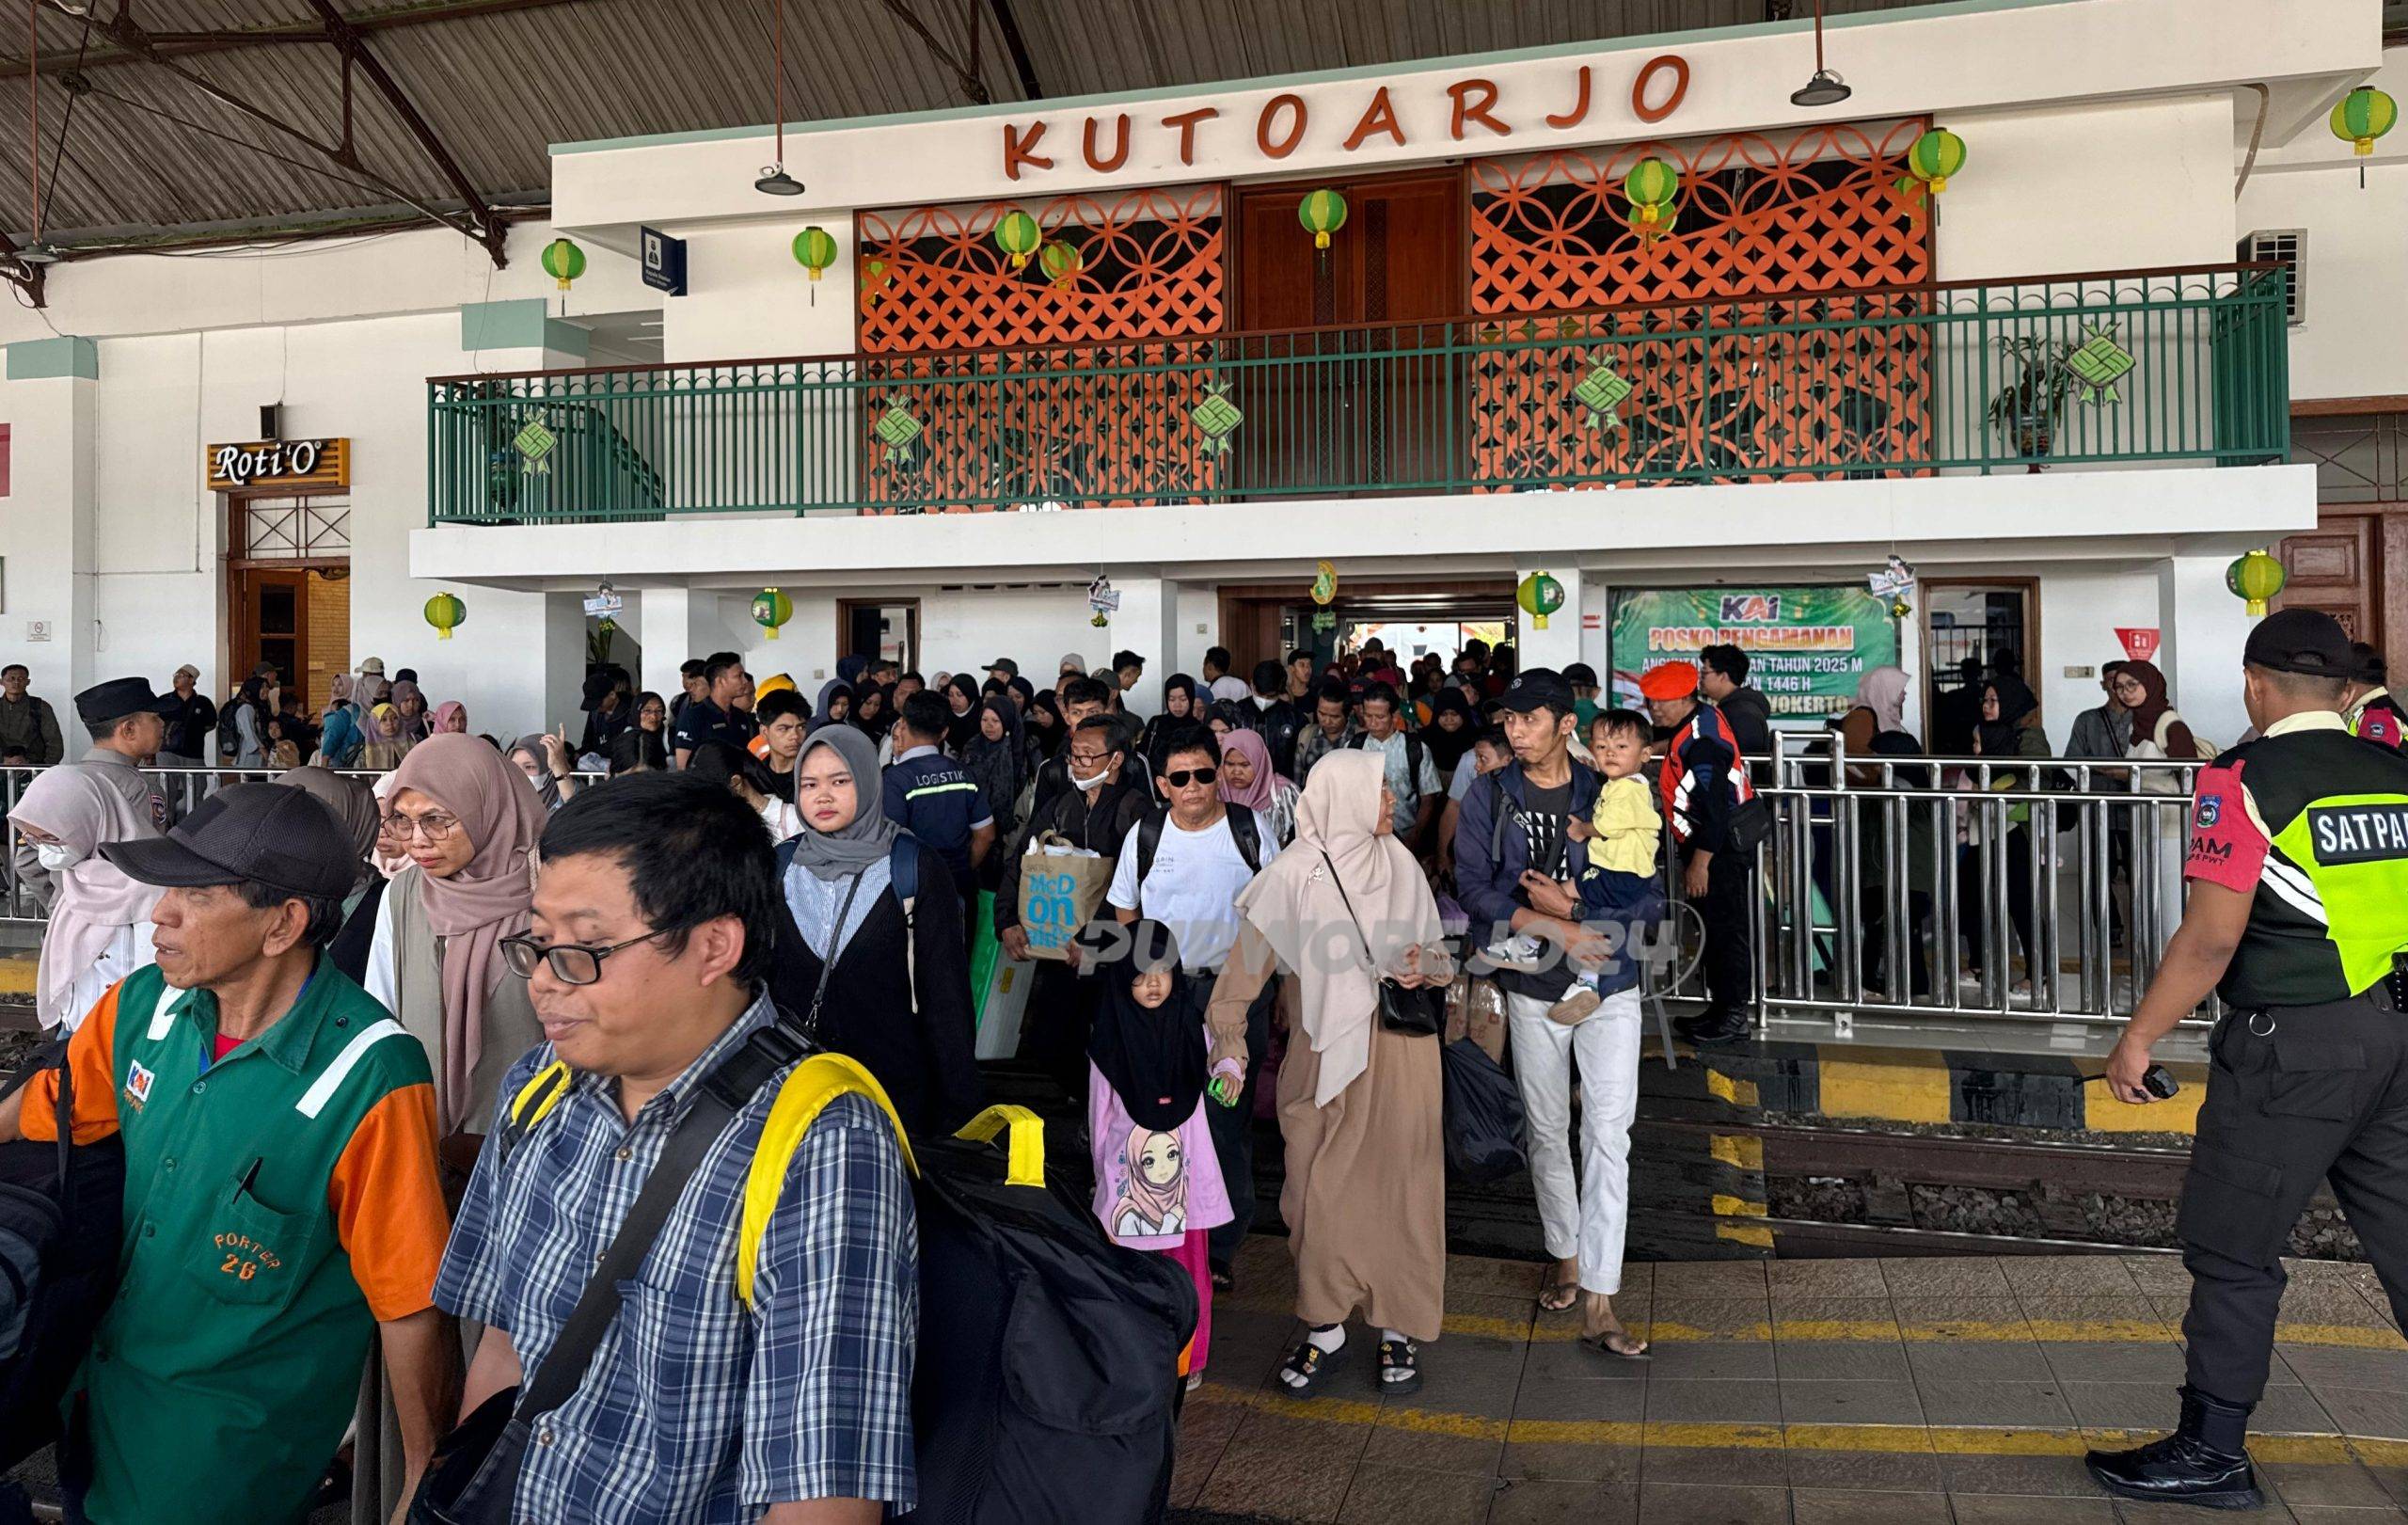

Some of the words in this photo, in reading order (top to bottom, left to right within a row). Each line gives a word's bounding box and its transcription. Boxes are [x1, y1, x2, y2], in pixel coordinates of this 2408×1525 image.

[1004, 55, 1690, 182] KUTOARJO
[1721, 596, 1779, 621] KAI
[1649, 627, 1715, 651] POSKO
[1718, 626, 1854, 650] PENGAMANAN
[1769, 657, 1811, 672] TAHUN
[1814, 657, 1848, 673] 2025
[1851, 657, 1862, 672] M
[1767, 676, 1798, 691] 1446
[1801, 676, 1811, 691] H
[915, 770, 964, 786] LOGISTIK
[214, 1232, 281, 1269] PORTER
[221, 1253, 257, 1280] 26
